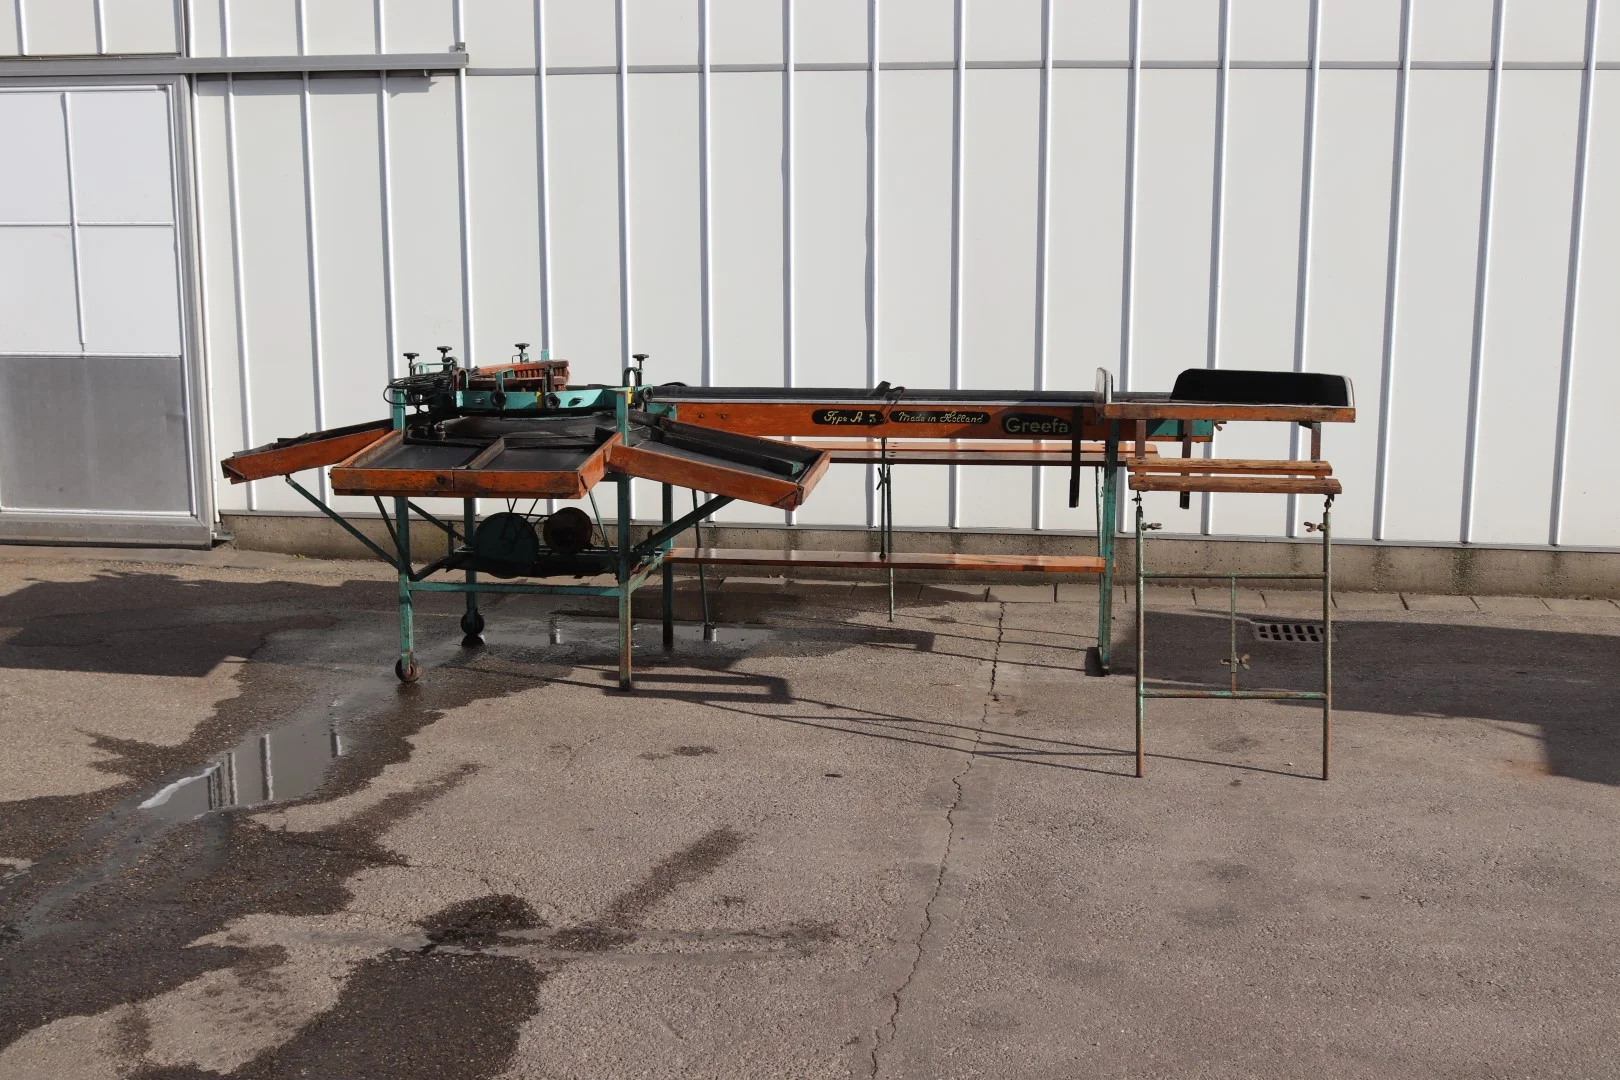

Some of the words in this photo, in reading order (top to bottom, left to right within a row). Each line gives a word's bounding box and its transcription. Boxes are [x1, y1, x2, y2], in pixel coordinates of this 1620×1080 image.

[824, 411, 847, 425] Type
[850, 411, 863, 422] A
[898, 412, 925, 422] Made
[927, 414, 937, 422] in
[939, 411, 983, 423] Holland
[1006, 418, 1068, 433] Greefa
